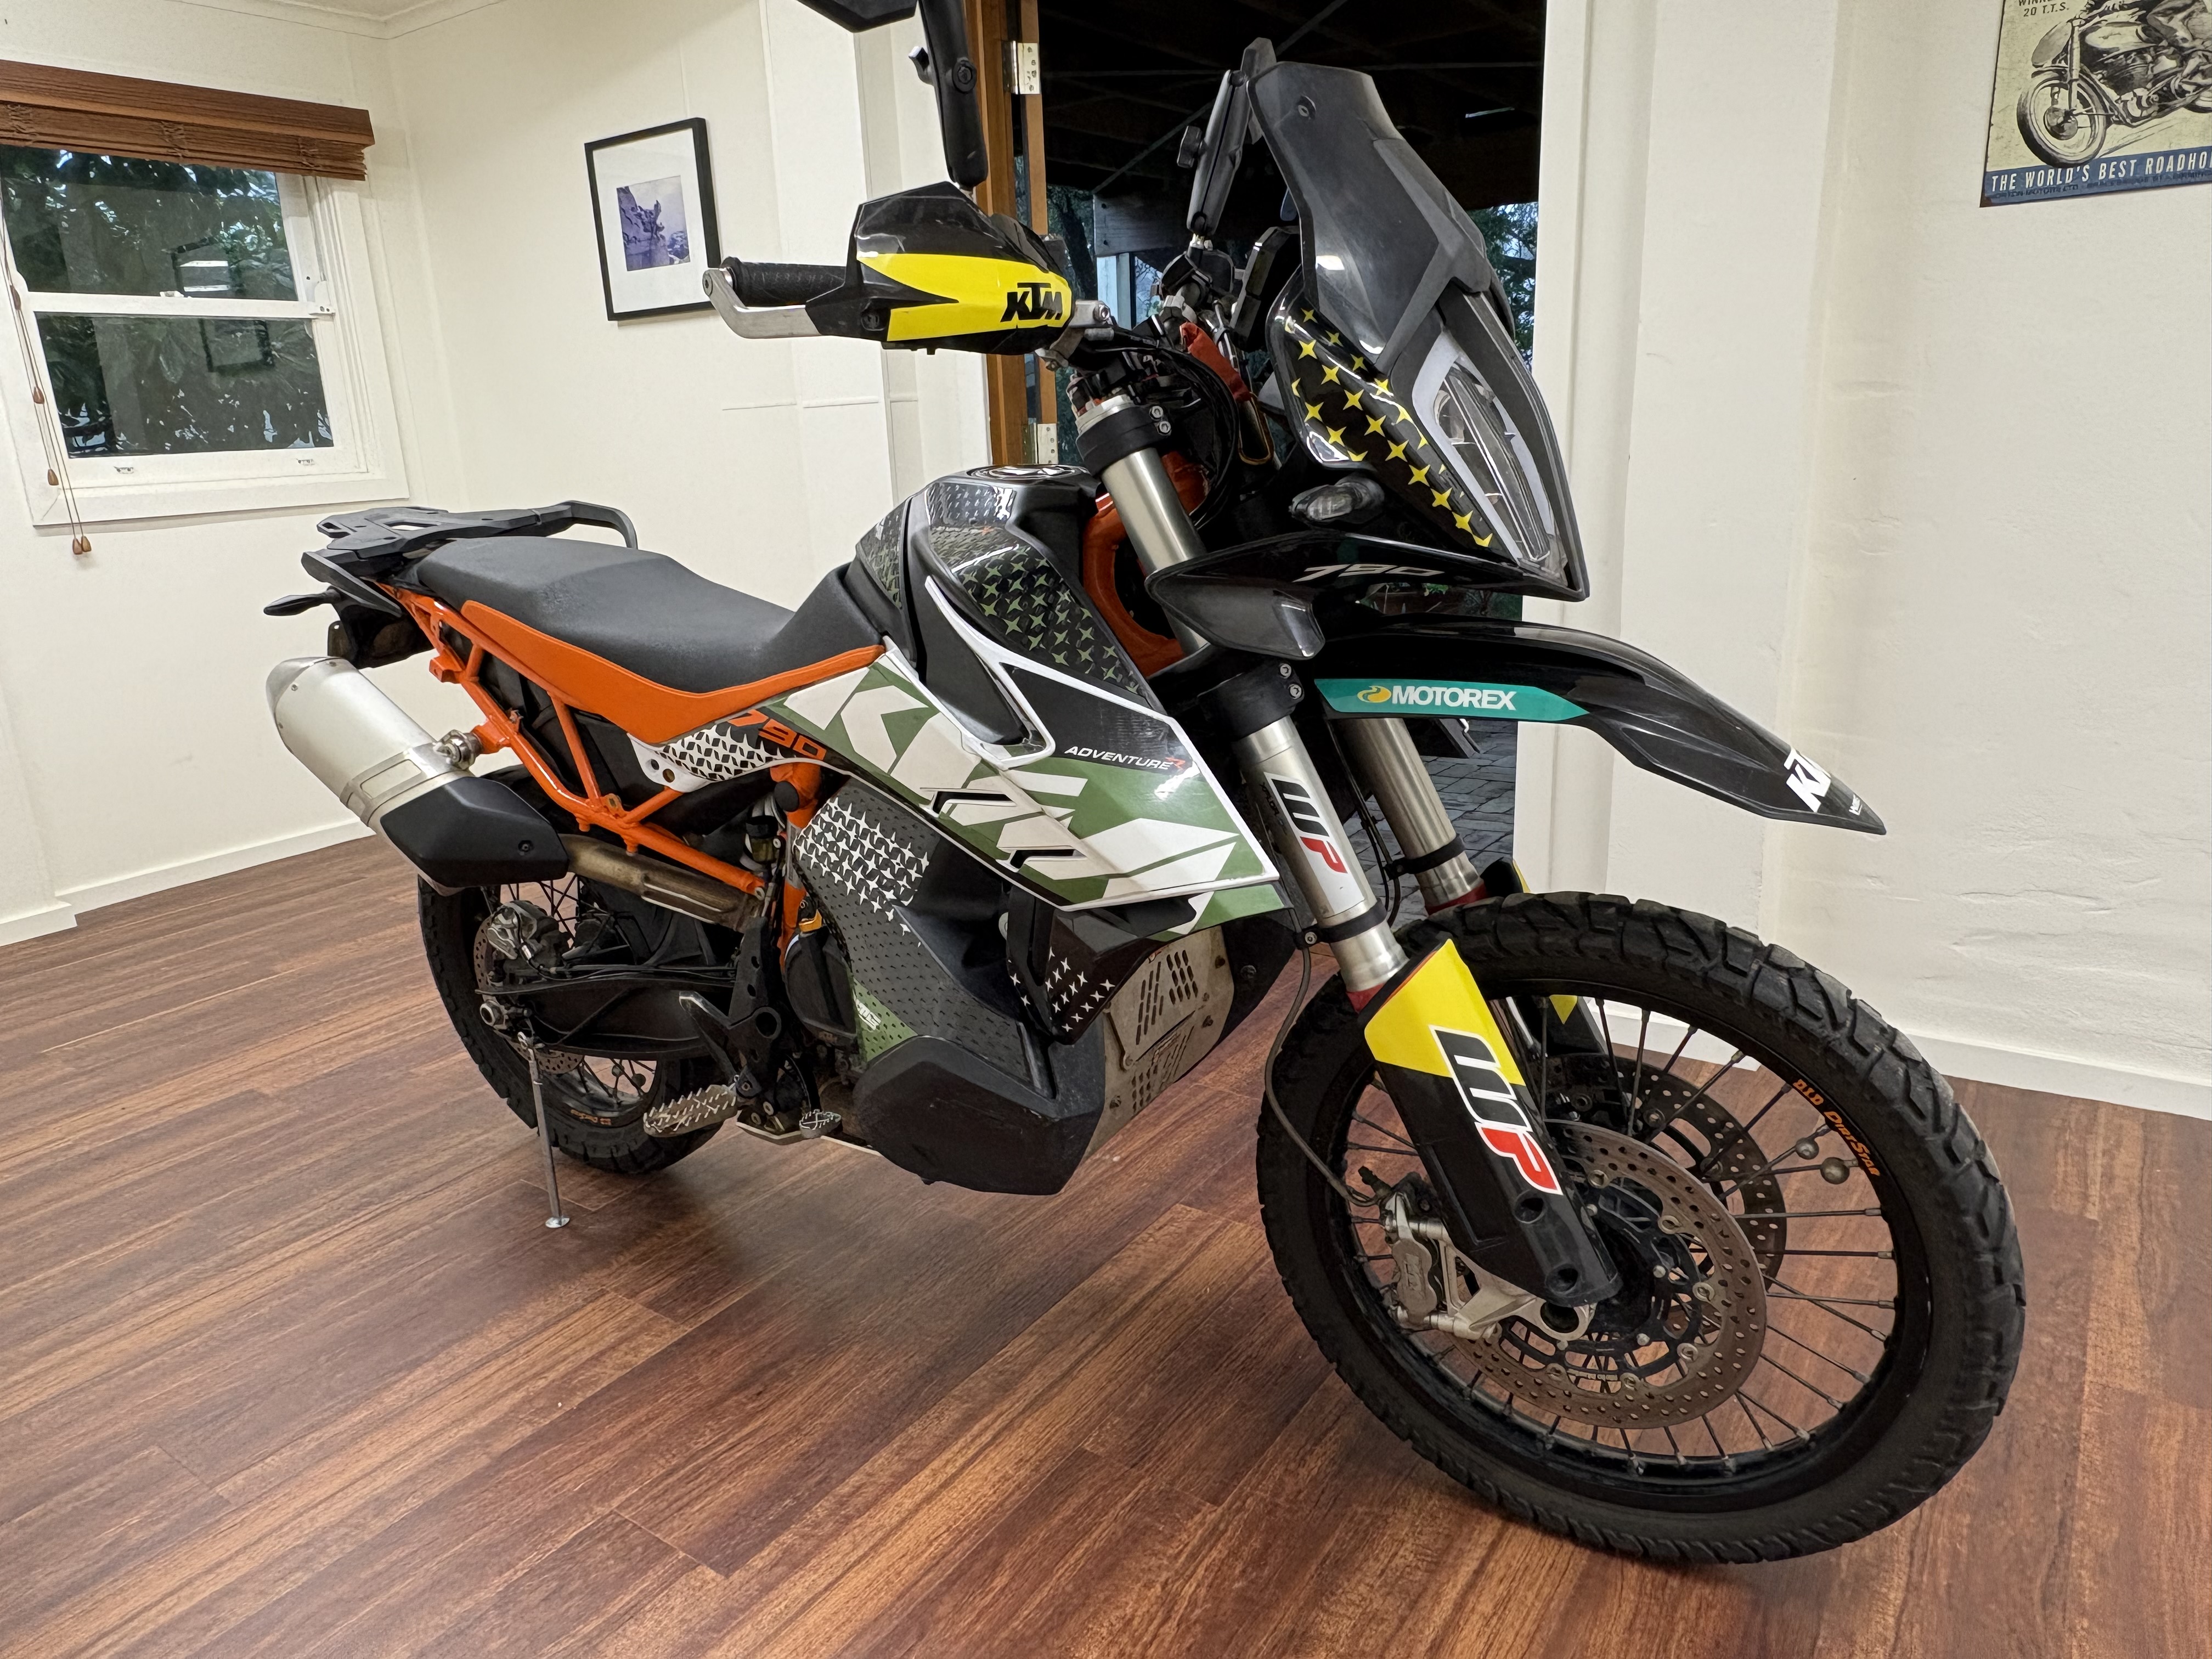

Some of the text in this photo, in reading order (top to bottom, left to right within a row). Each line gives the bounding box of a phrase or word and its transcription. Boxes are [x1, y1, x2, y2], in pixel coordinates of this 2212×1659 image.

[2023, 7, 2037, 17] 20
[1992, 173, 2017, 192] THE
[2025, 164, 2090, 189] WORLD'S
[2098, 159, 2137, 180] BEST
[1000, 283, 1063, 323] KTM
[1291, 563, 1446, 583] 790
[1392, 685, 1517, 711] MOTOREX
[727, 709, 827, 760] 790
[1064, 746, 1174, 770] ADVENTURE
